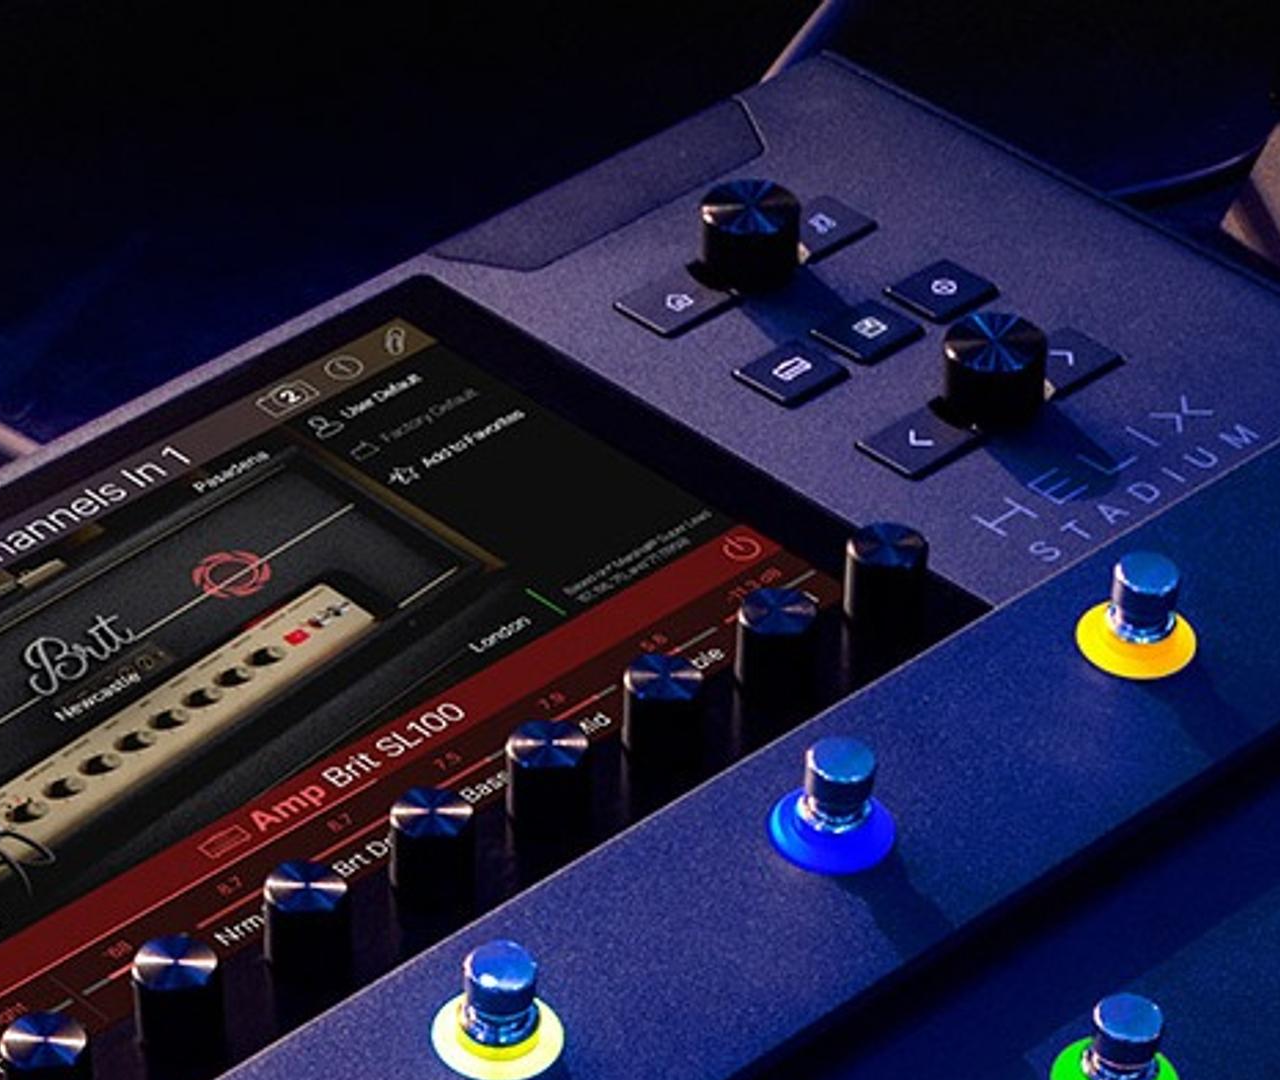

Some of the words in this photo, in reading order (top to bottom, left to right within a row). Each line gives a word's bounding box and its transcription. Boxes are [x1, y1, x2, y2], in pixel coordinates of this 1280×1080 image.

[120, 456, 168, 489] In
[161, 446, 191, 466] 1
[192, 451, 270, 493] Pasadena
[972, 394, 1214, 537] HELIX
[1029, 423, 1260, 562] STADIUM
[24, 614, 137, 696] Brit
[468, 615, 532, 653] London
[54, 672, 141, 721] Newcastle
[250, 785, 326, 831] Amp
[322, 752, 382, 788] Brit
[376, 703, 465, 758] SL100
[332, 853, 371, 877] Brt
[214, 915, 265, 946] Nrm
